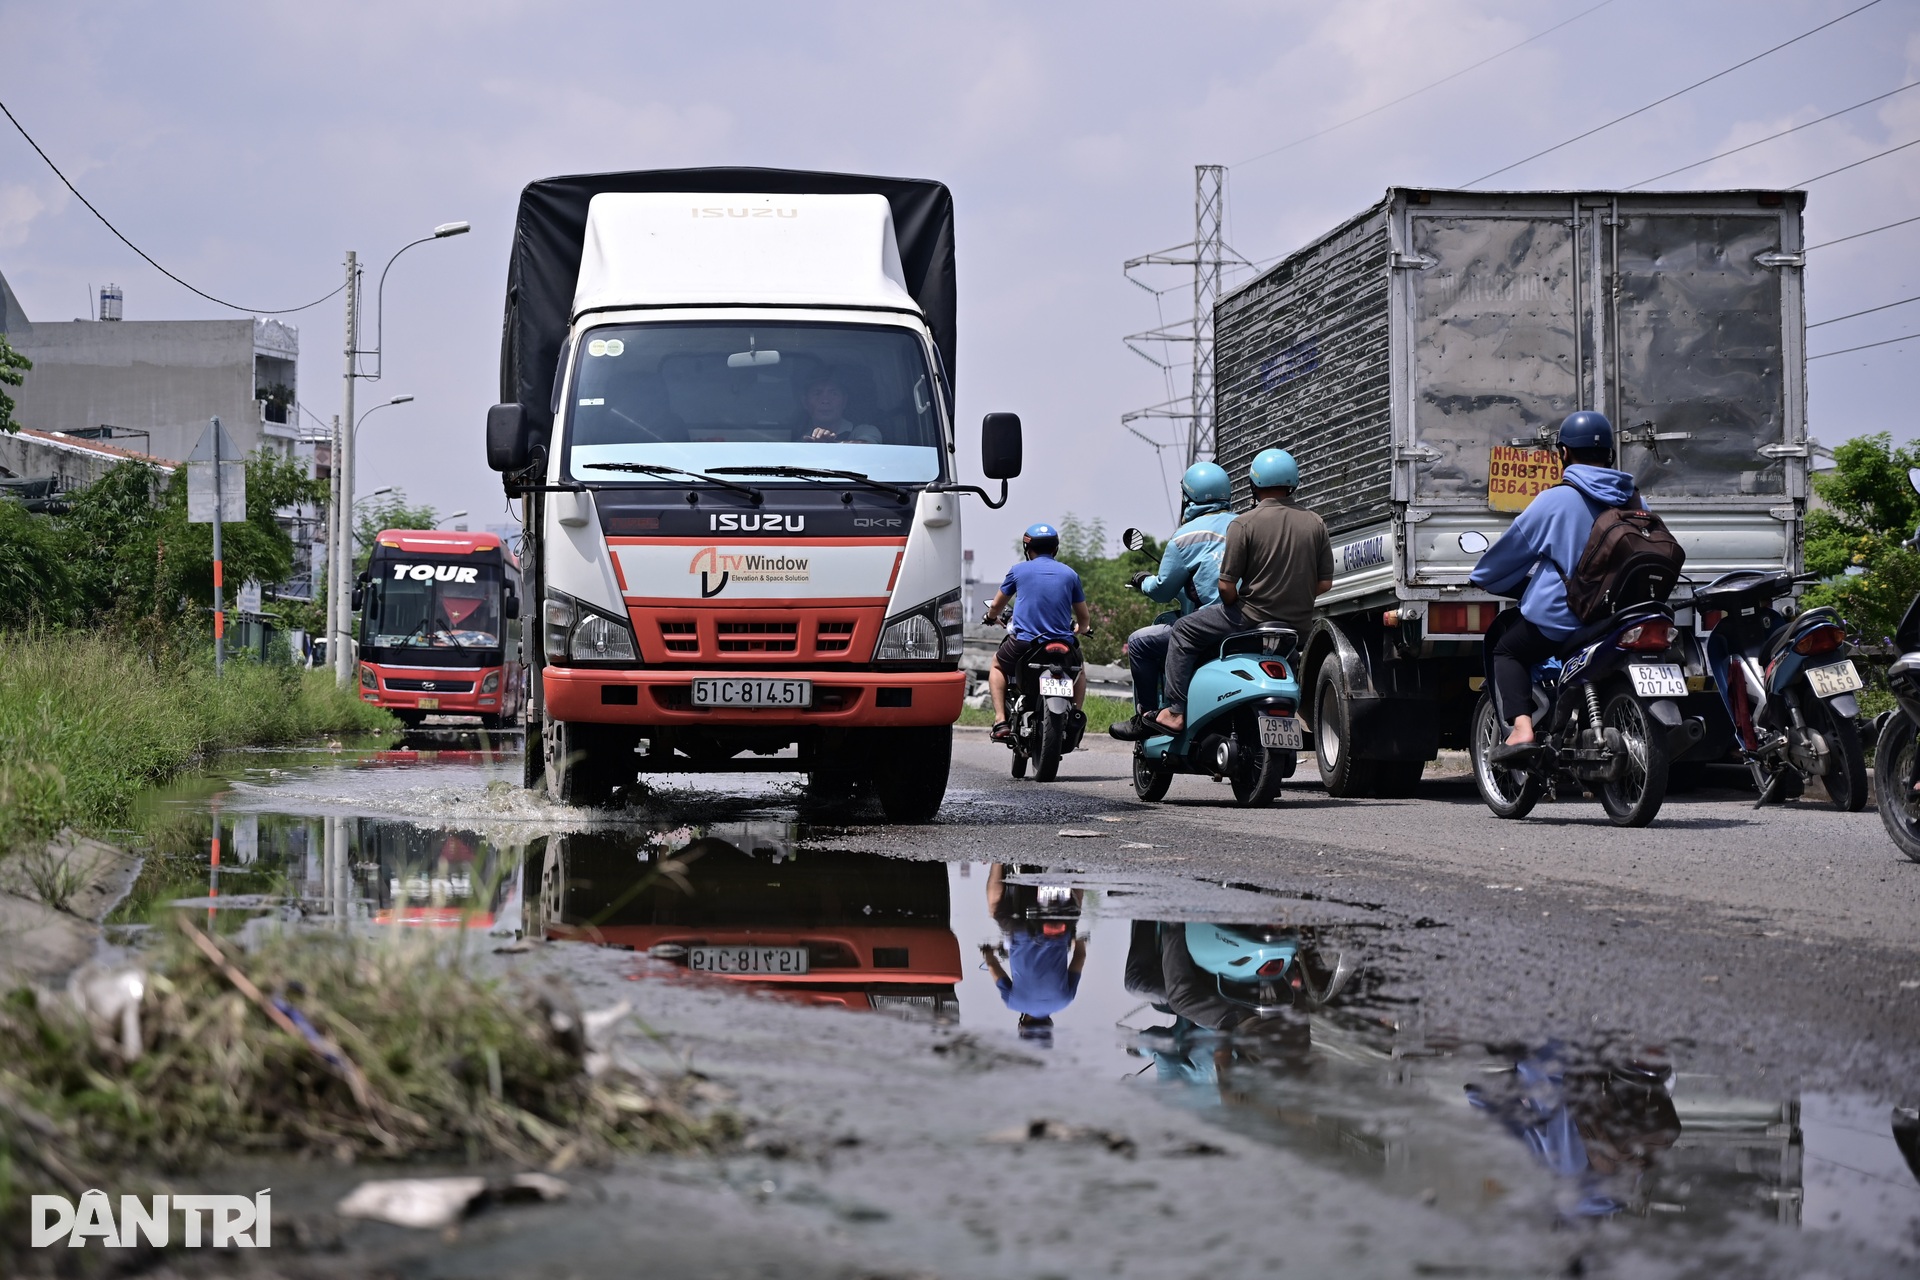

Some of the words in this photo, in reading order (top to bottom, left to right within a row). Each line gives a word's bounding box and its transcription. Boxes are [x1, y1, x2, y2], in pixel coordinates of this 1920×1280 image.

[691, 208, 798, 219] ISUZU
[1491, 462, 1564, 480] 0918379
[710, 514, 805, 532] ISUZU
[853, 518, 902, 528] QKR
[745, 555, 808, 571] Window
[393, 564, 478, 584] TOUR
[731, 574, 759, 582] Elevation
[765, 575, 784, 583] Space
[784, 574, 809, 582] Solution
[1639, 667, 1674, 680] 62-U1
[1814, 664, 1849, 682] 54-X8
[696, 681, 804, 704] 51C-814.51
[1638, 681, 1684, 694] 207.49
[1820, 676, 1855, 694] 0459
[1265, 719, 1294, 733] 29-BK
[1264, 732, 1299, 747] 020.69
